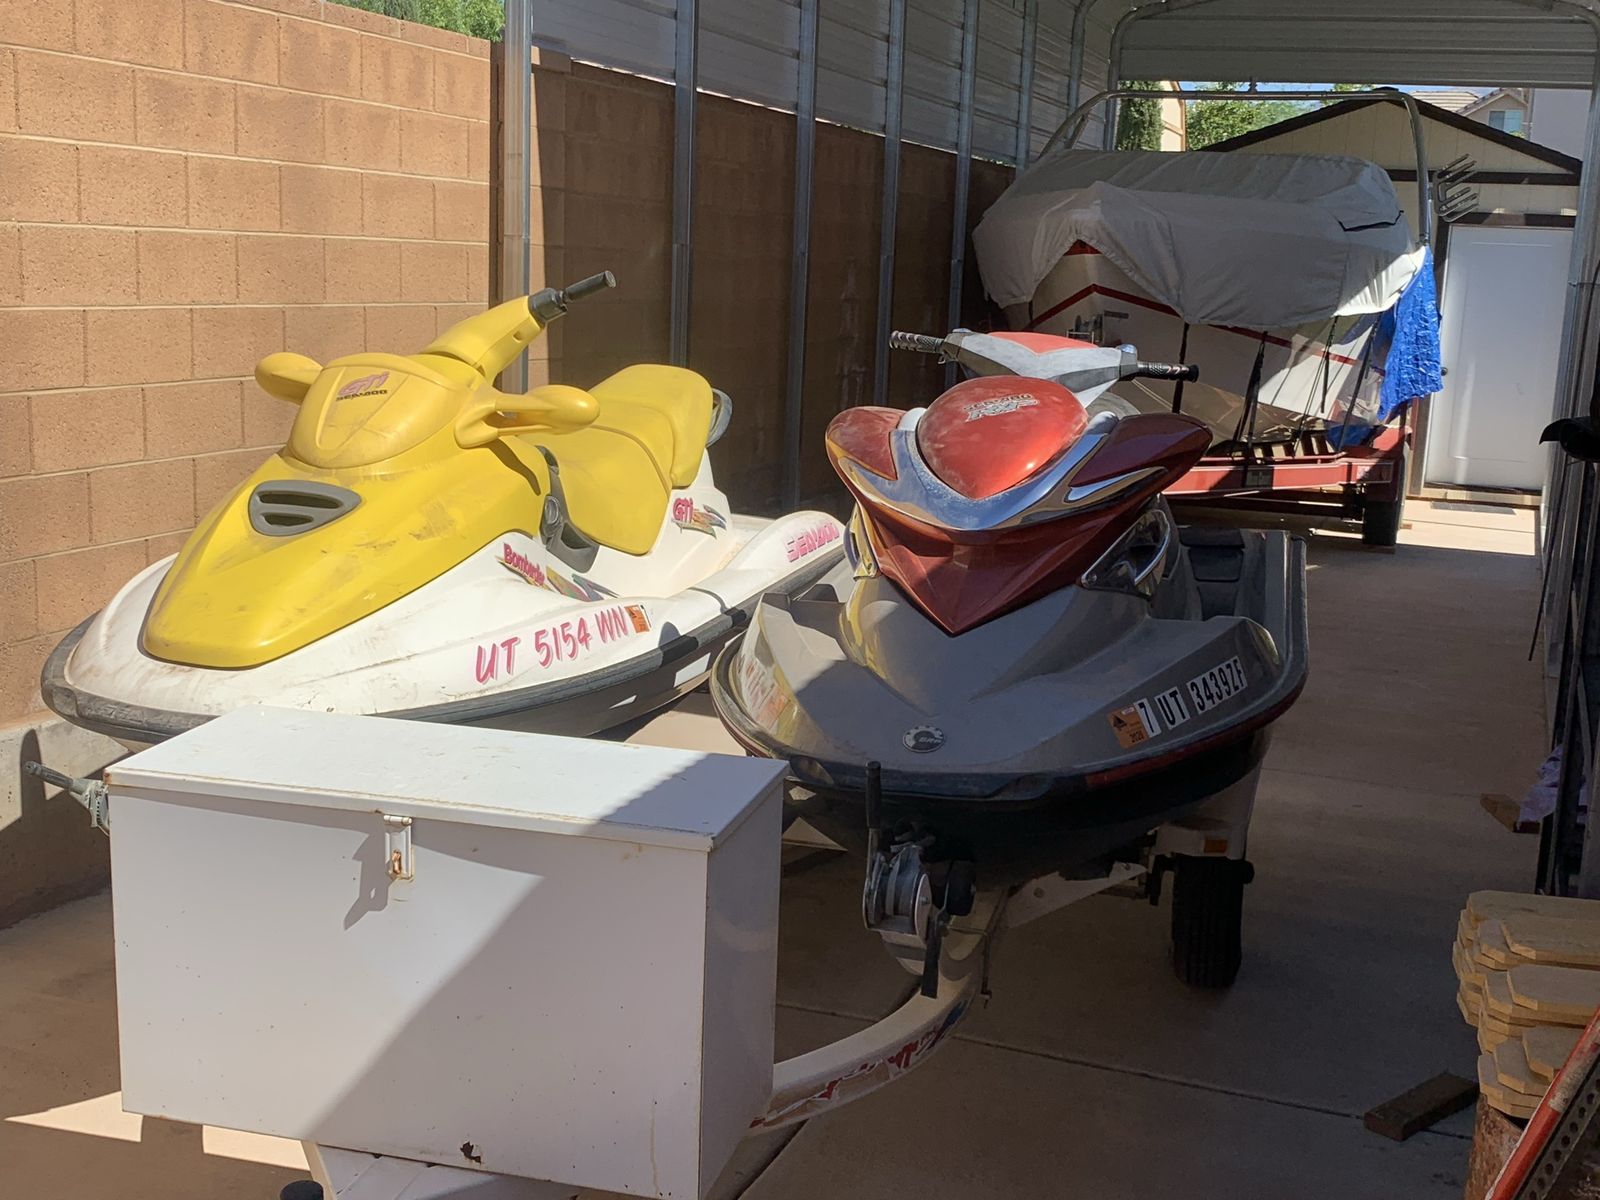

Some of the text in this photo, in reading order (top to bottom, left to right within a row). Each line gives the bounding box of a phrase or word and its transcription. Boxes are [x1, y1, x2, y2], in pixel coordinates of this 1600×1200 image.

[475, 636, 520, 685] UT
[534, 617, 592, 668] 5154
[594, 605, 629, 643] WN
[1138, 659, 1244, 733] 7 UT 3439ZF
